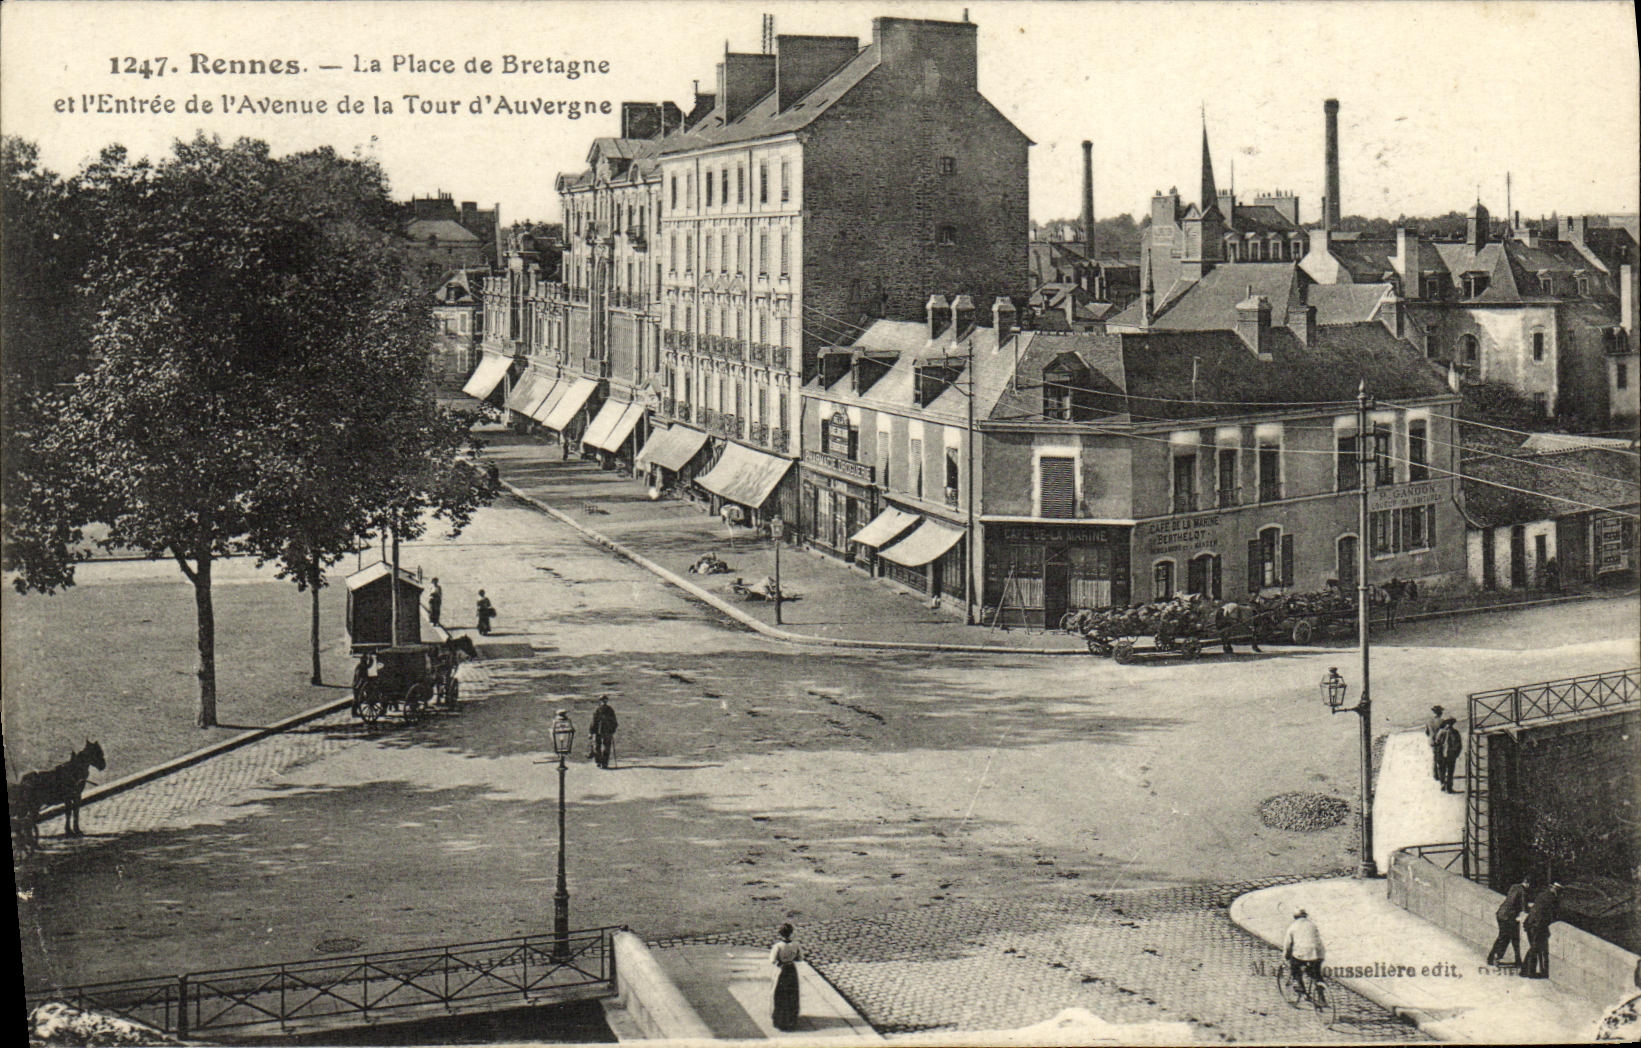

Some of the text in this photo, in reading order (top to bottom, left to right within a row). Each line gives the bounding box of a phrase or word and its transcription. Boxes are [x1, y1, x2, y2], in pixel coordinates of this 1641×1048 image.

[1172, 520, 1181, 531] DE
[1183, 519, 1191, 530] LA
[1194, 516, 1220, 528] MARINE
